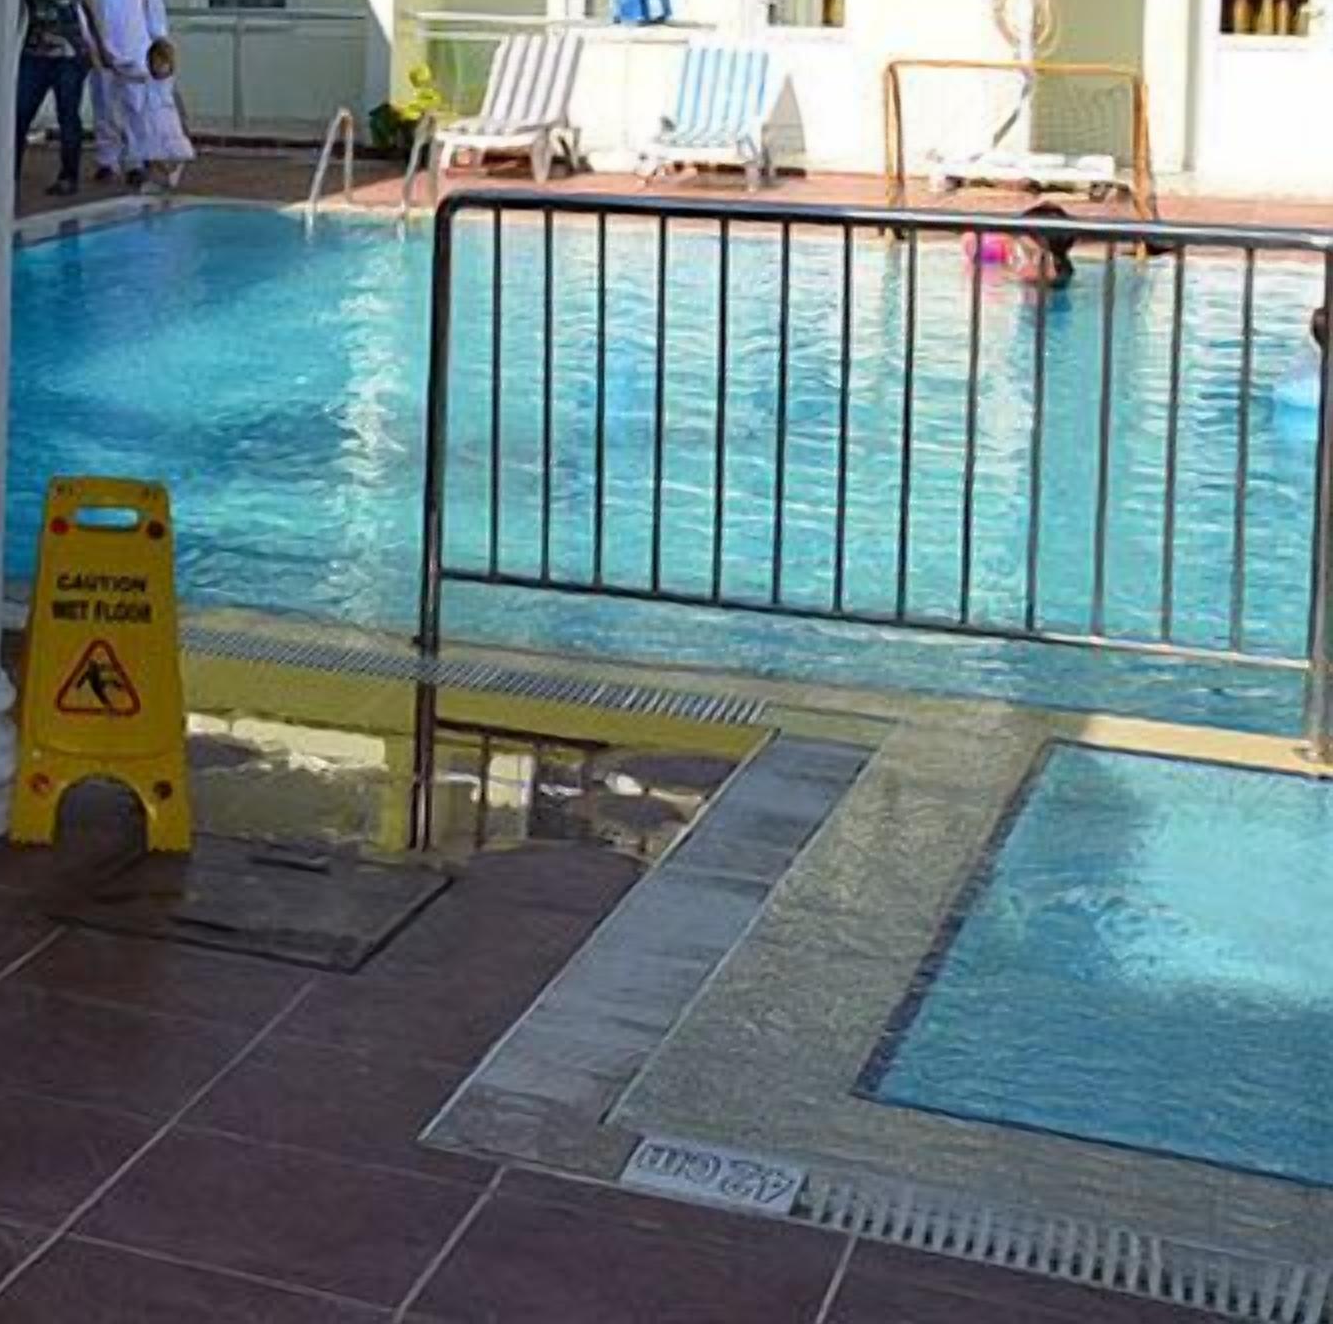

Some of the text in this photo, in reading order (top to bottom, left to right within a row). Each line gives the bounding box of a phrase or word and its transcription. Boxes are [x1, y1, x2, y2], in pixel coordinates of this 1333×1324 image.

[56, 574, 147, 593] CAUTION
[52, 600, 152, 623] WET FLOOR
